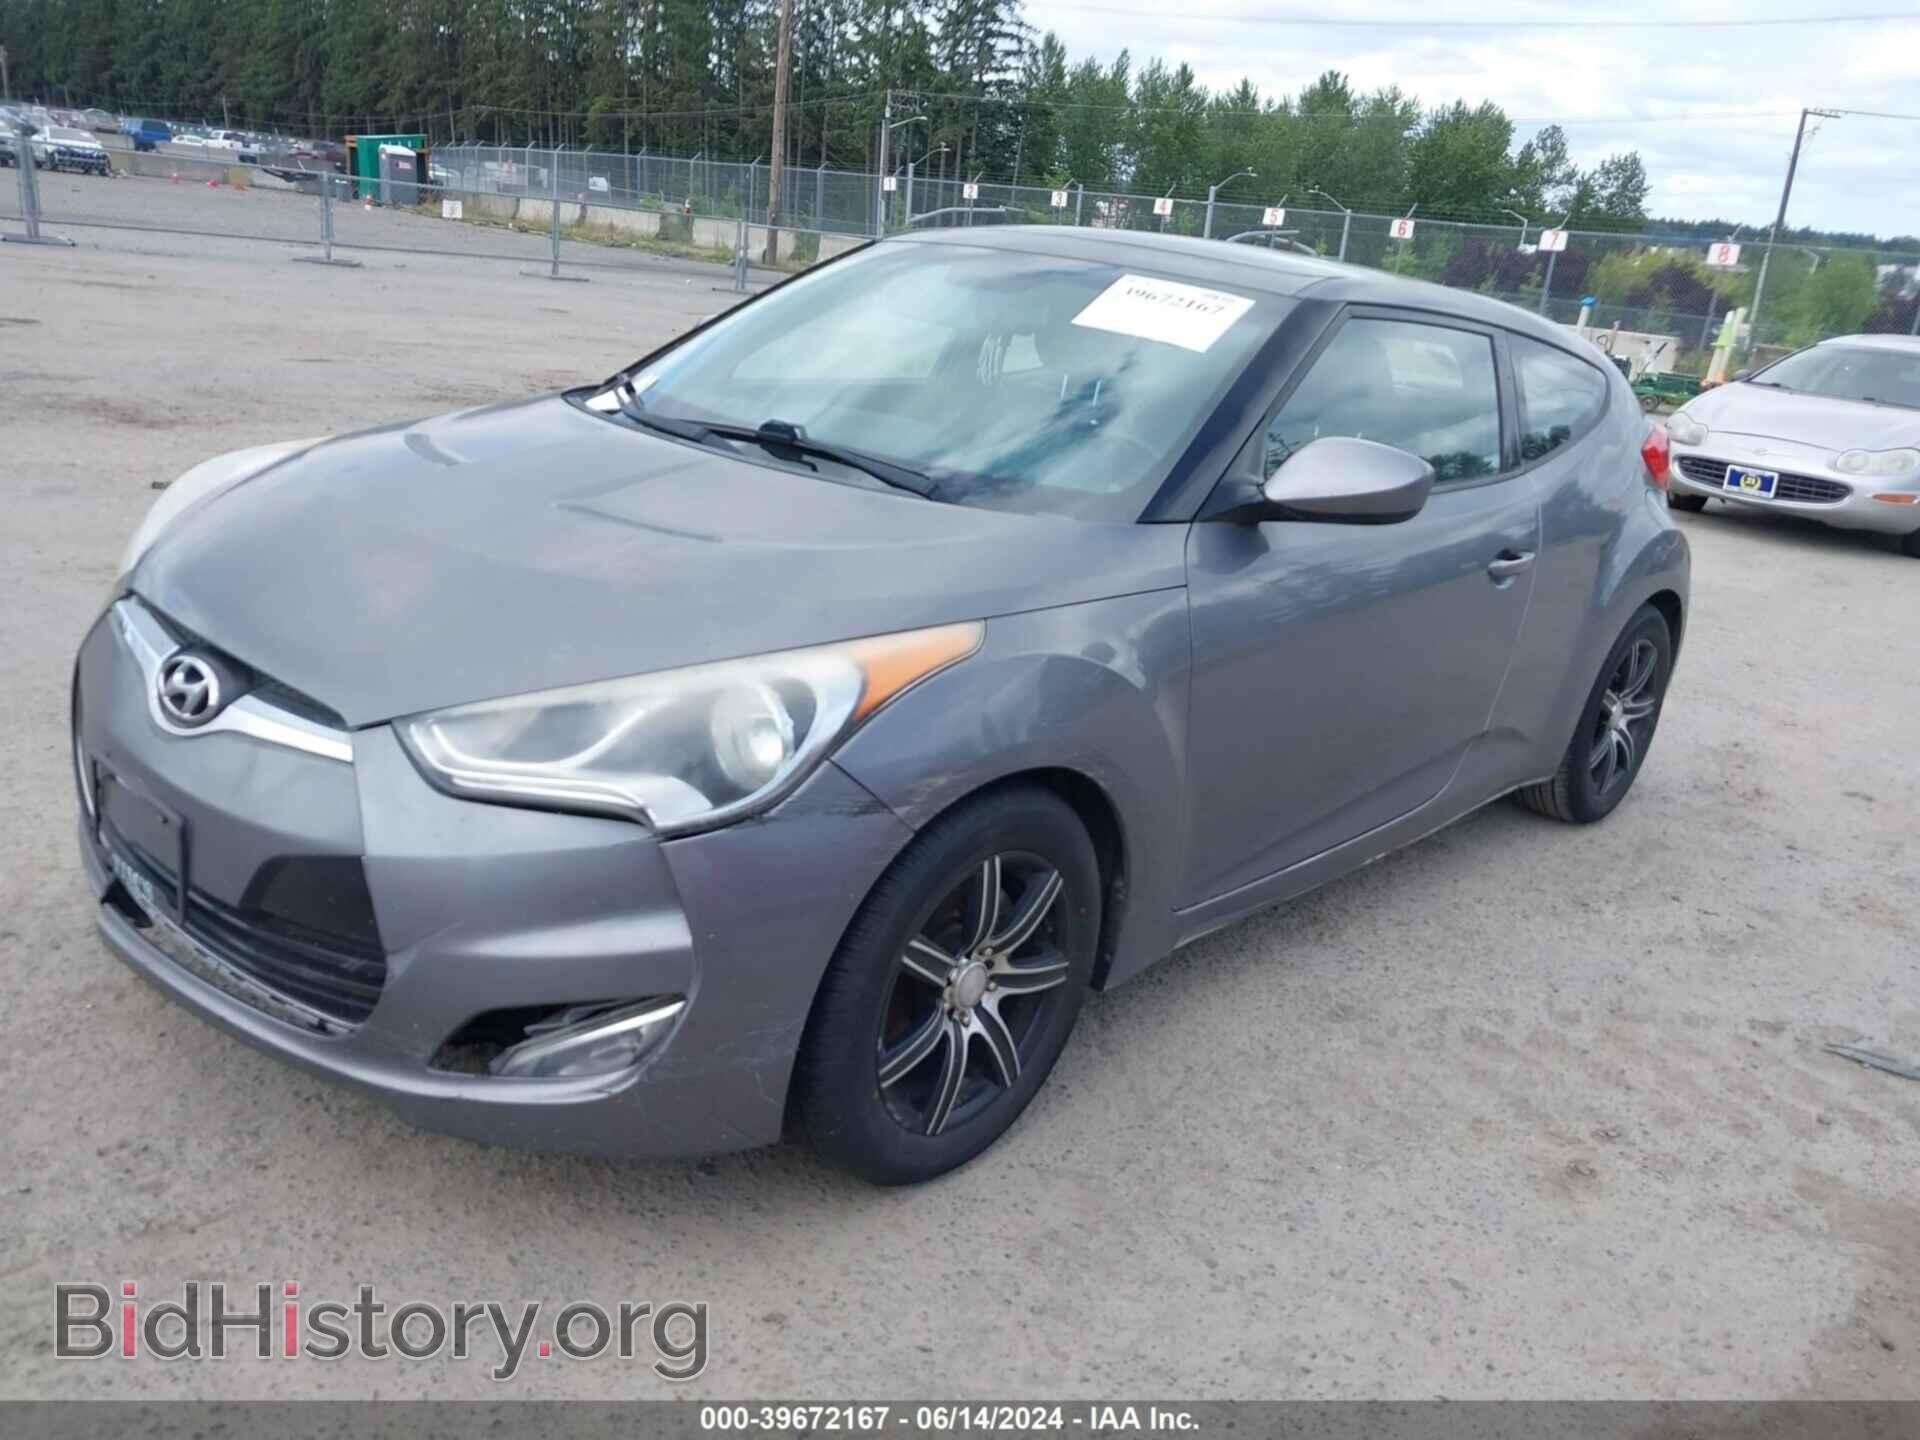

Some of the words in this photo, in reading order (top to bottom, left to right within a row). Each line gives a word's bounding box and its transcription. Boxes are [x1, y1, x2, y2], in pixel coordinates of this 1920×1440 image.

[1270, 208, 1278, 223] 5
[1398, 221, 1407, 235] 6
[1719, 244, 1729, 262] 8
